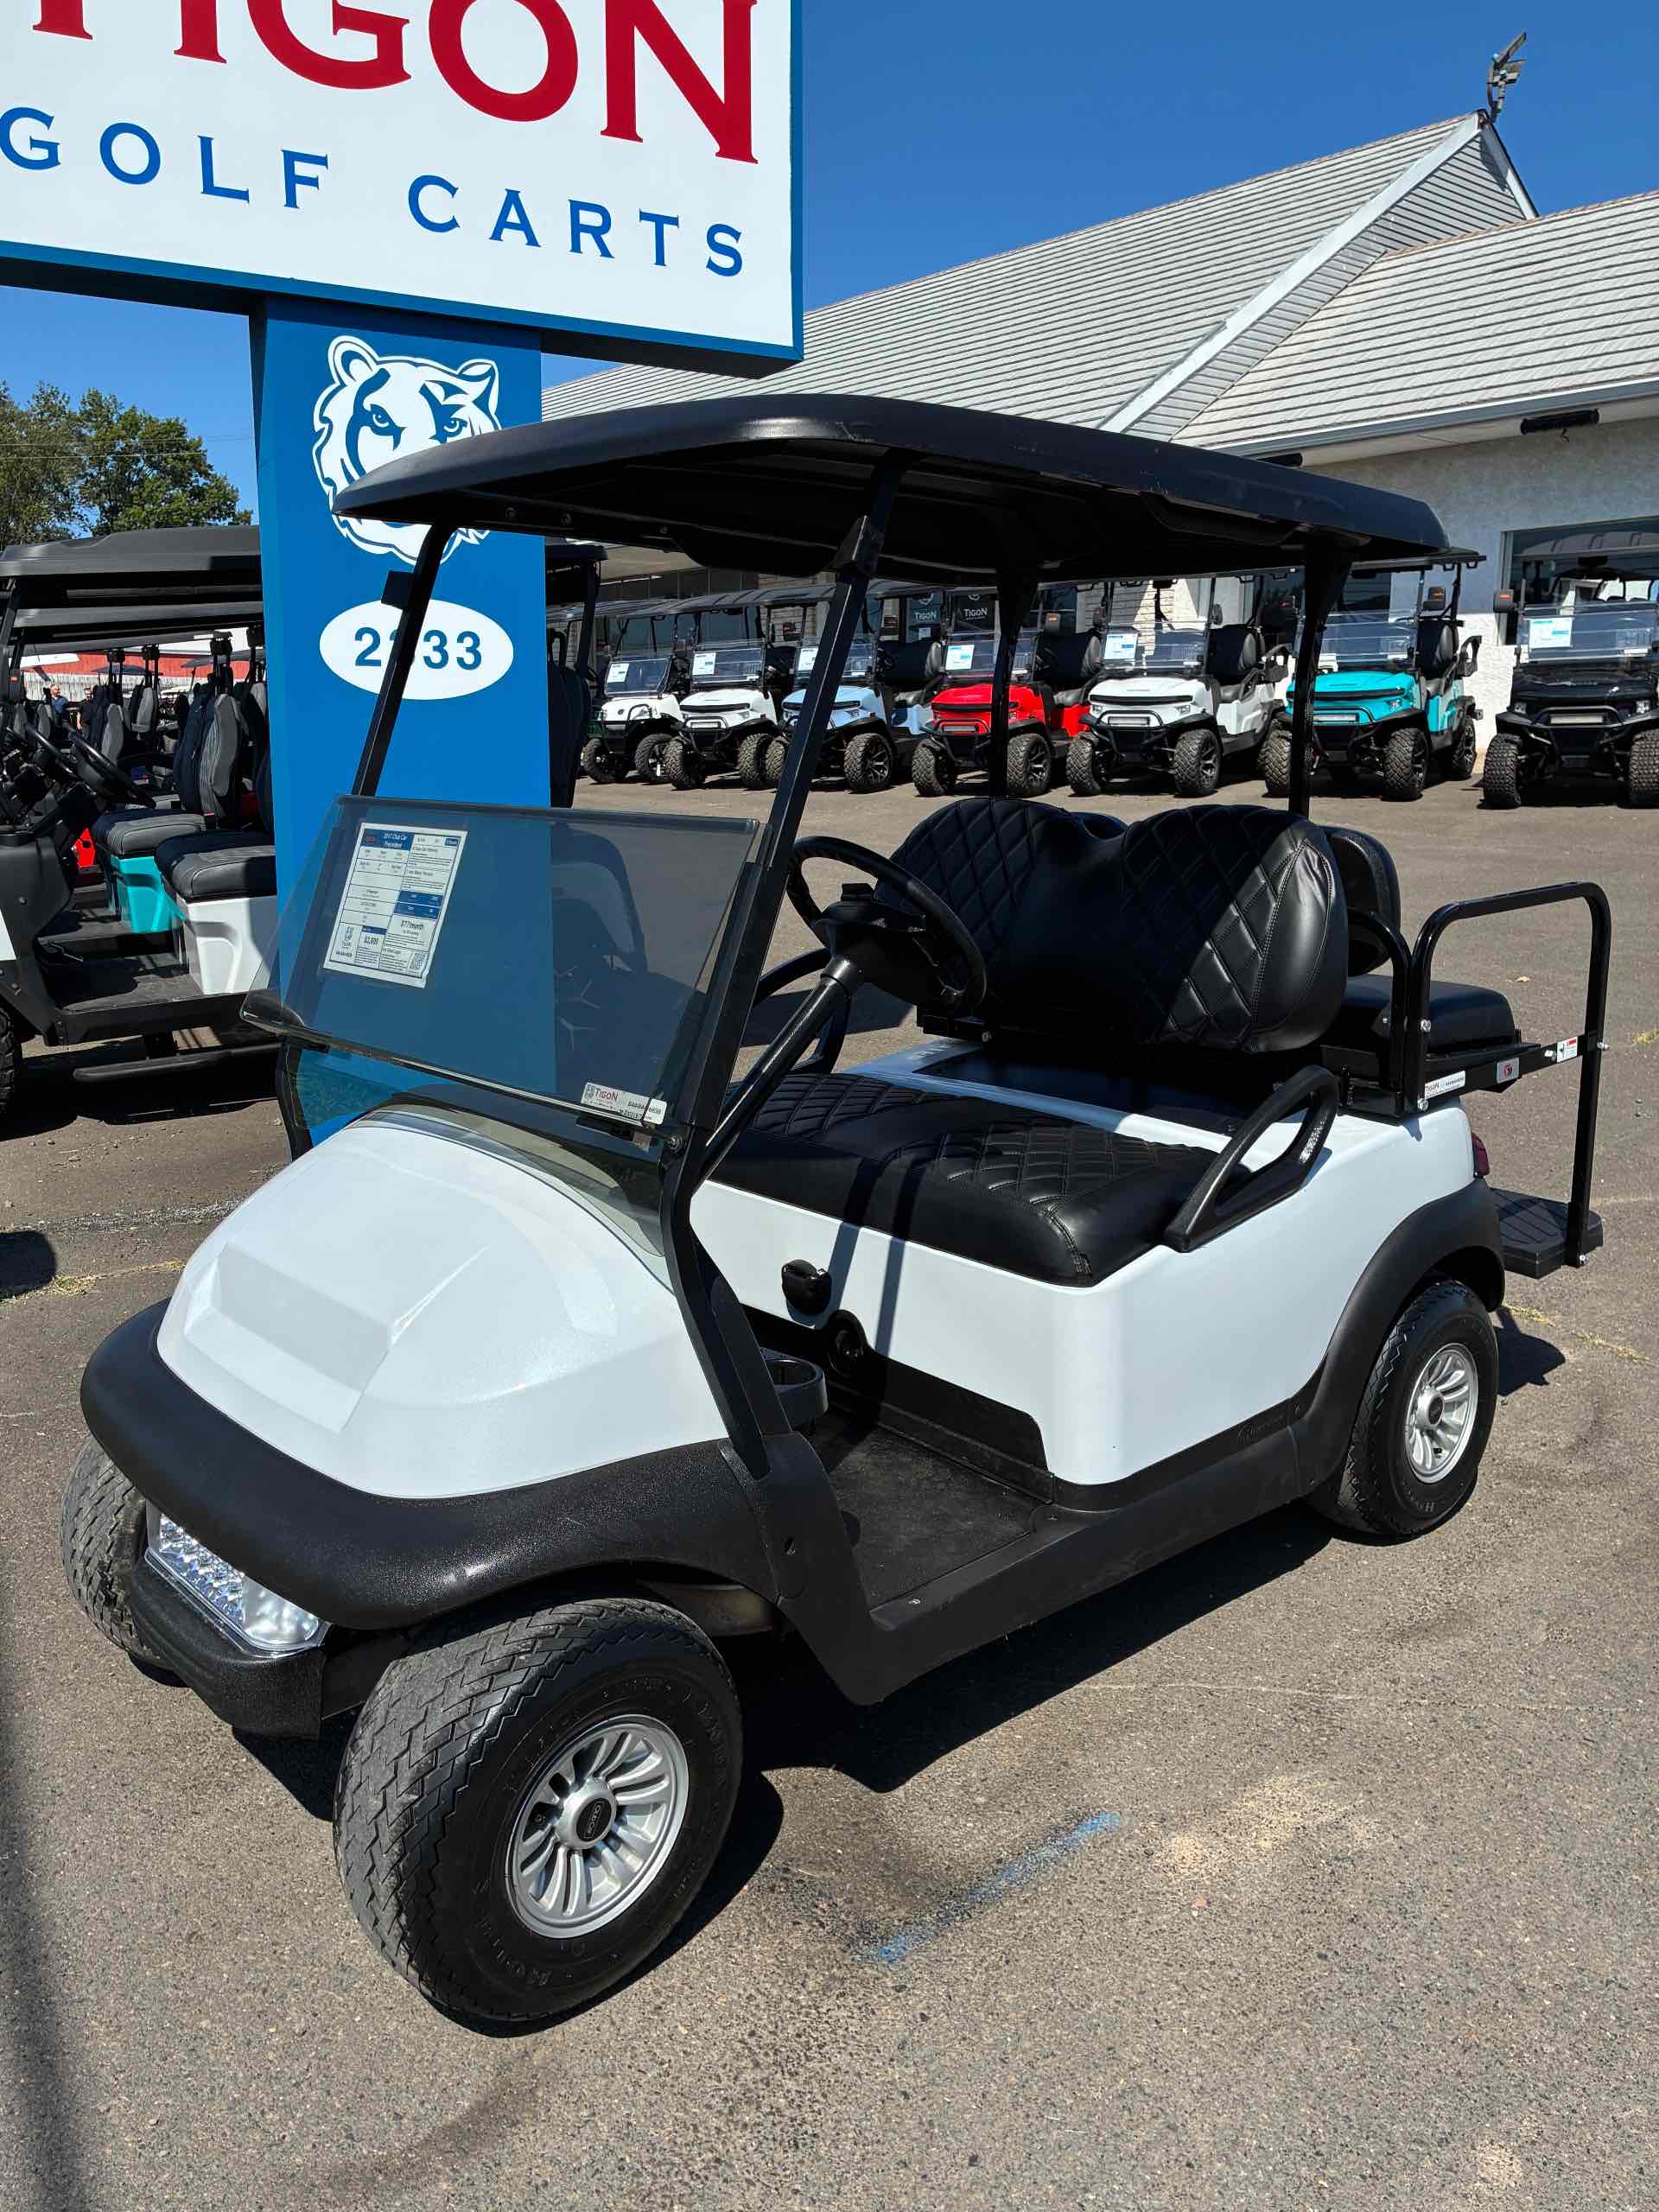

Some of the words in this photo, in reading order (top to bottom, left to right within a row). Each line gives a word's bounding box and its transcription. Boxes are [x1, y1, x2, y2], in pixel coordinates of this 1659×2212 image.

[33, 0, 758, 164] GON
[0, 106, 328, 209] GOLF
[407, 174, 744, 277] CARTS
[354, 627, 482, 671] 233
[595, 1088, 619, 1101] TIGON
